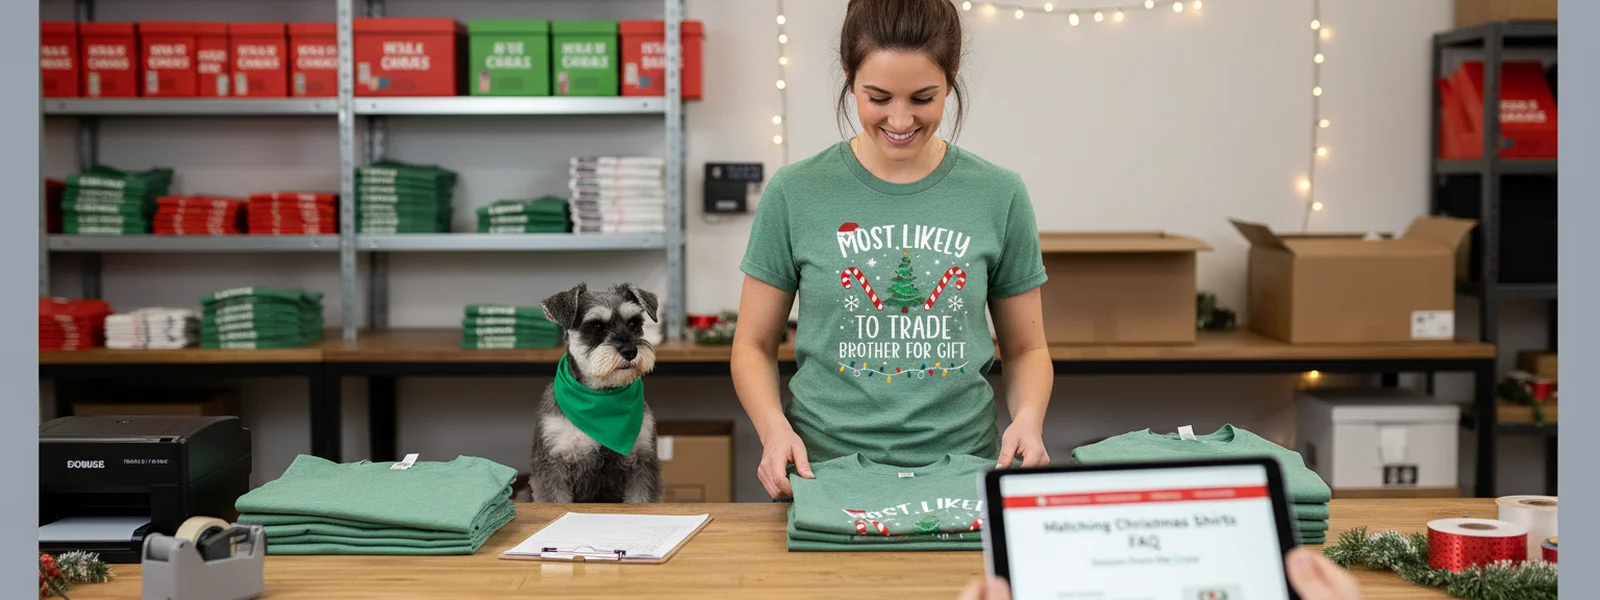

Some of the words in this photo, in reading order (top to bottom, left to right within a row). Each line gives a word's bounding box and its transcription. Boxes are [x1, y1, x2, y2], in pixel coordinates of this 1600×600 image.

[837, 225, 895, 258] MOST
[903, 224, 971, 258] LIKELY
[855, 315, 879, 339] TO
[887, 315, 952, 339] TRADE
[839, 342, 900, 358] BROTHER
[906, 342, 931, 358] FOR
[937, 342, 966, 358] GIFT
[921, 498, 984, 513] LIKEL
[1043, 518, 1111, 535] Matching
[1115, 516, 1188, 530] Christmas
[1193, 513, 1237, 527] Shirts
[1128, 534, 1161, 550] FAQ
